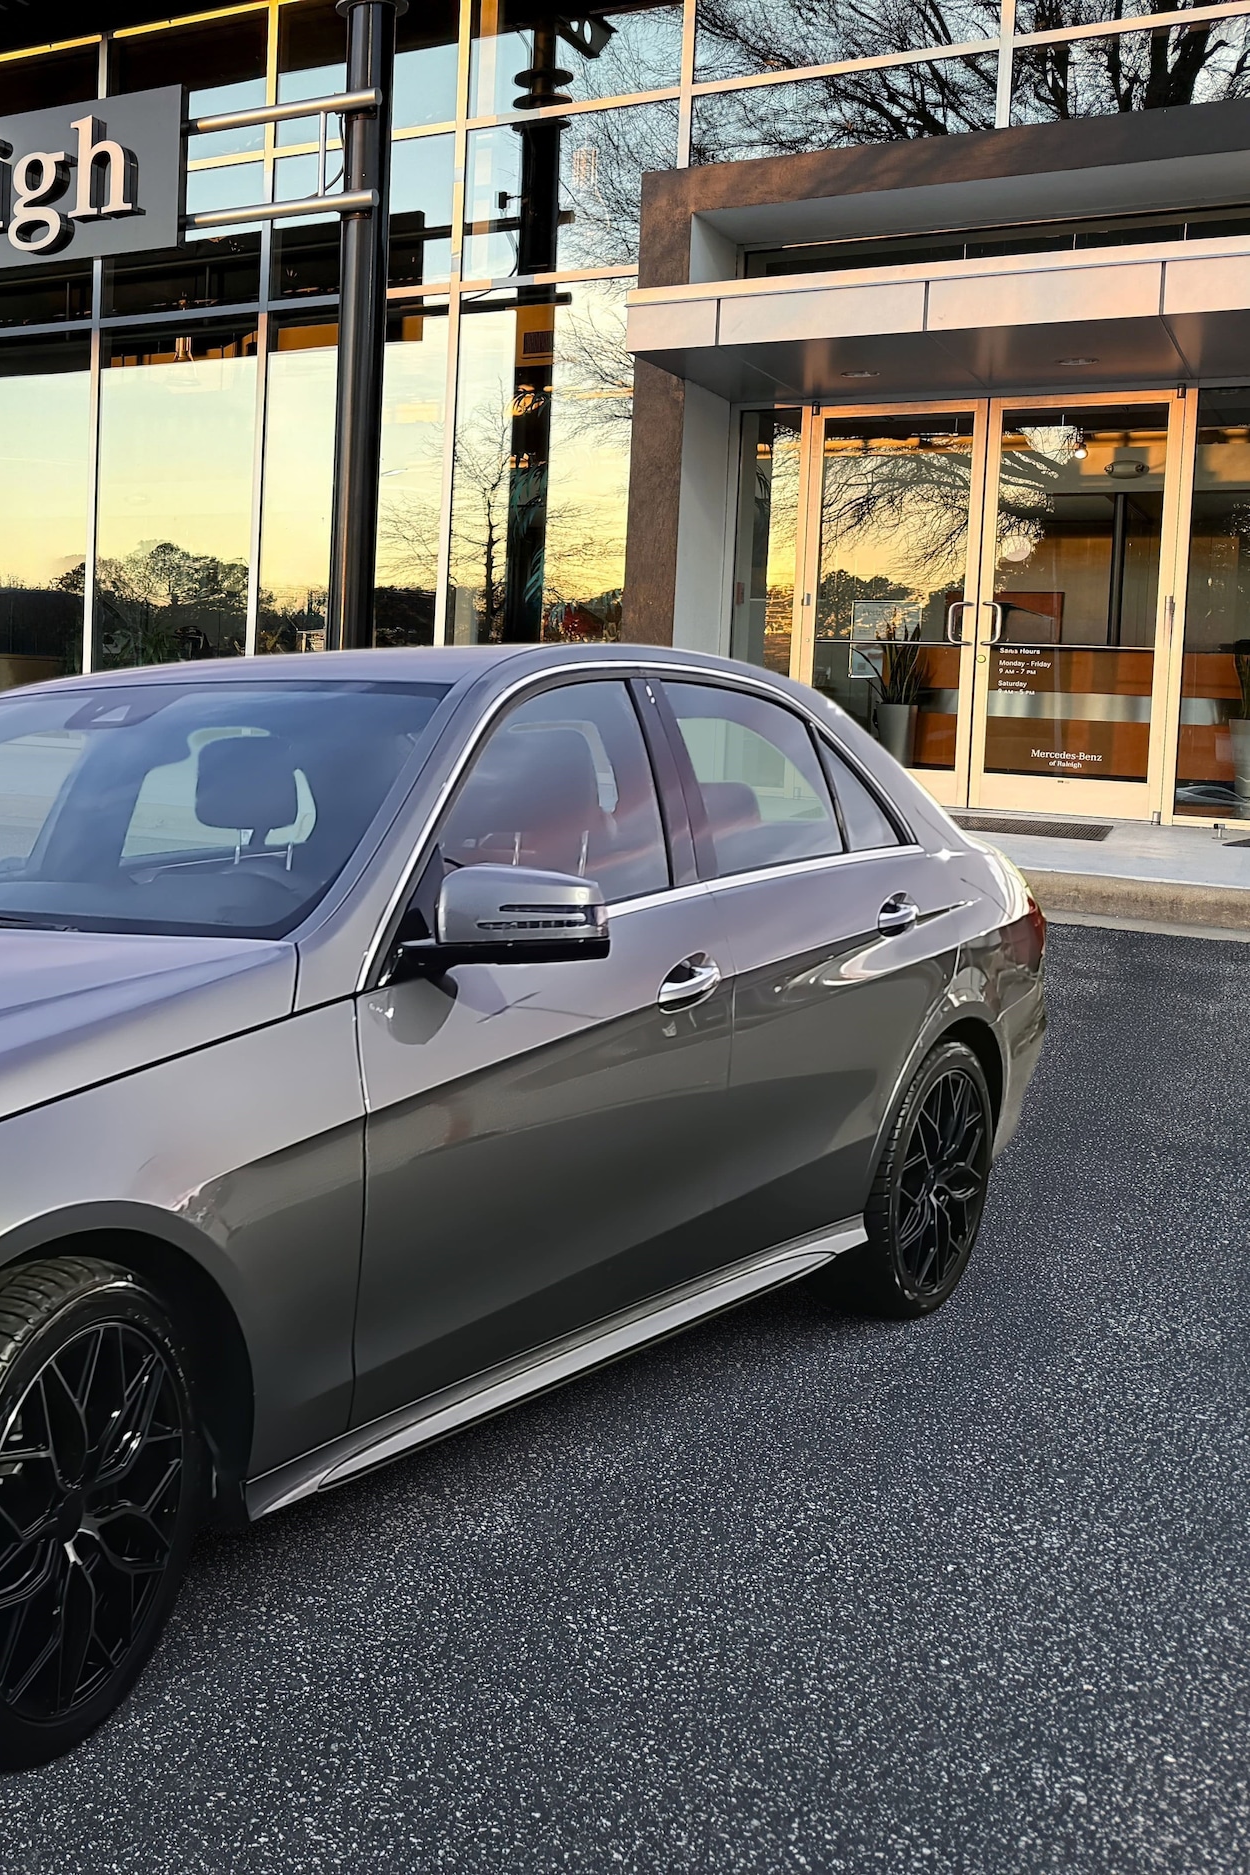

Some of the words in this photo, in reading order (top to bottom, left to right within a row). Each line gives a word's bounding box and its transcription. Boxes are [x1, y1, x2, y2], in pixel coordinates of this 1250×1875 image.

[998, 680, 1027, 688] Saturday
[1031, 749, 1103, 762] Mercedes-Benz
[1057, 761, 1082, 769] Raleigh
